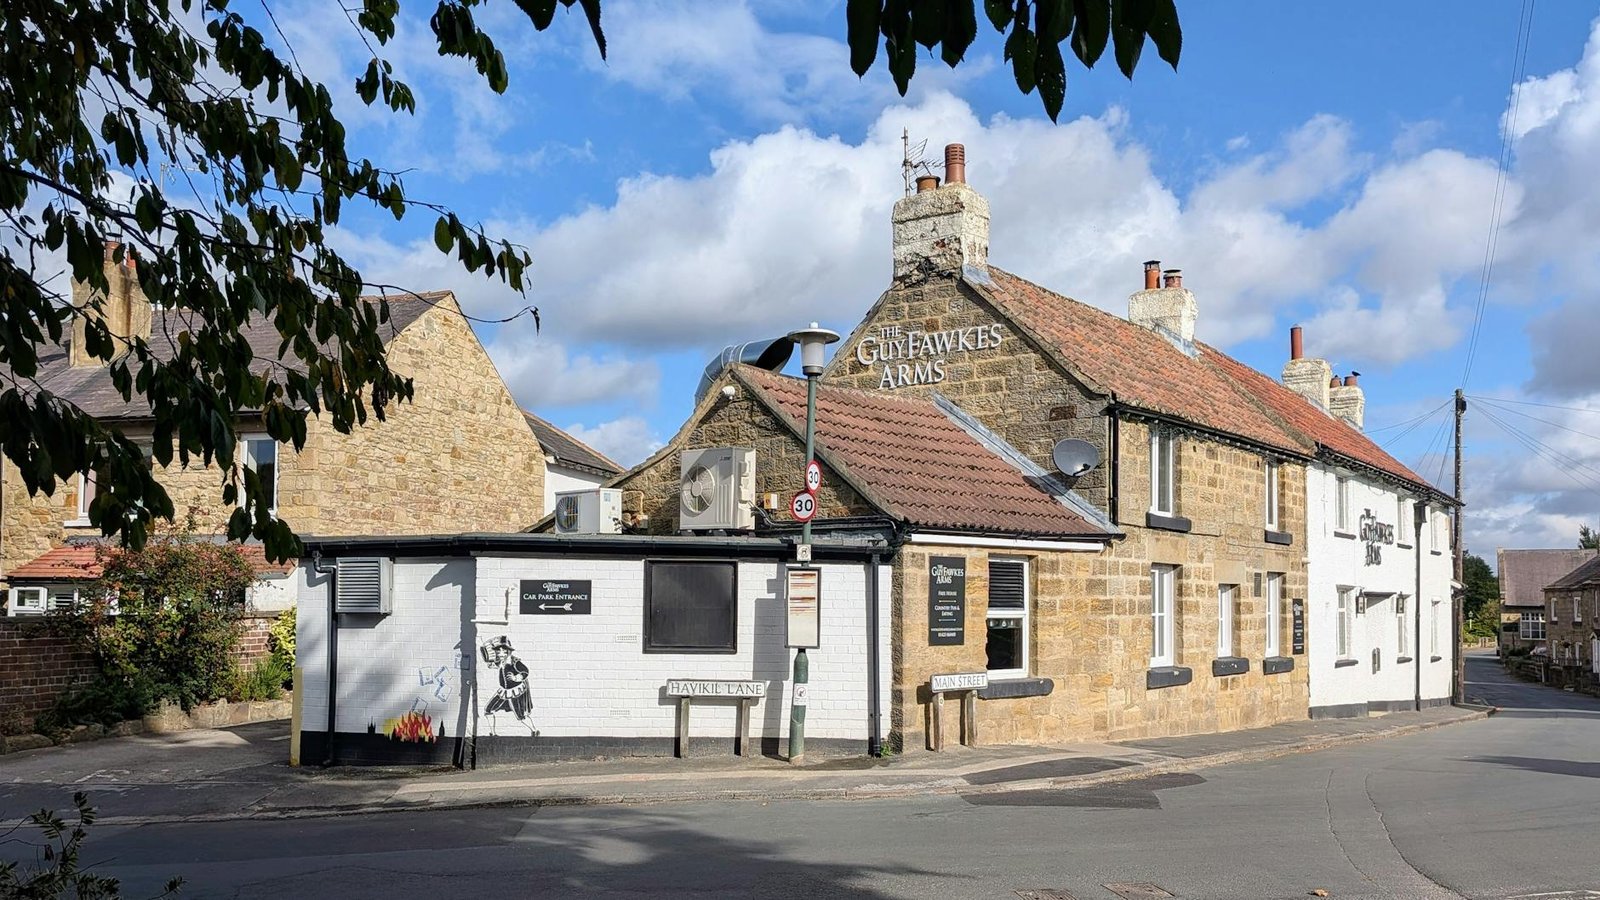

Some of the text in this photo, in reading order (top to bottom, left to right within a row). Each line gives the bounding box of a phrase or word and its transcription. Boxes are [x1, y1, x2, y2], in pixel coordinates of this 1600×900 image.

[880, 326, 901, 338] THE
[878, 359, 945, 390] ARMS
[808, 471, 818, 484] 30
[795, 499, 813, 512] 30
[934, 675, 986, 688] MAIN STREET
[671, 682, 763, 695] HAVIKIL LANE
